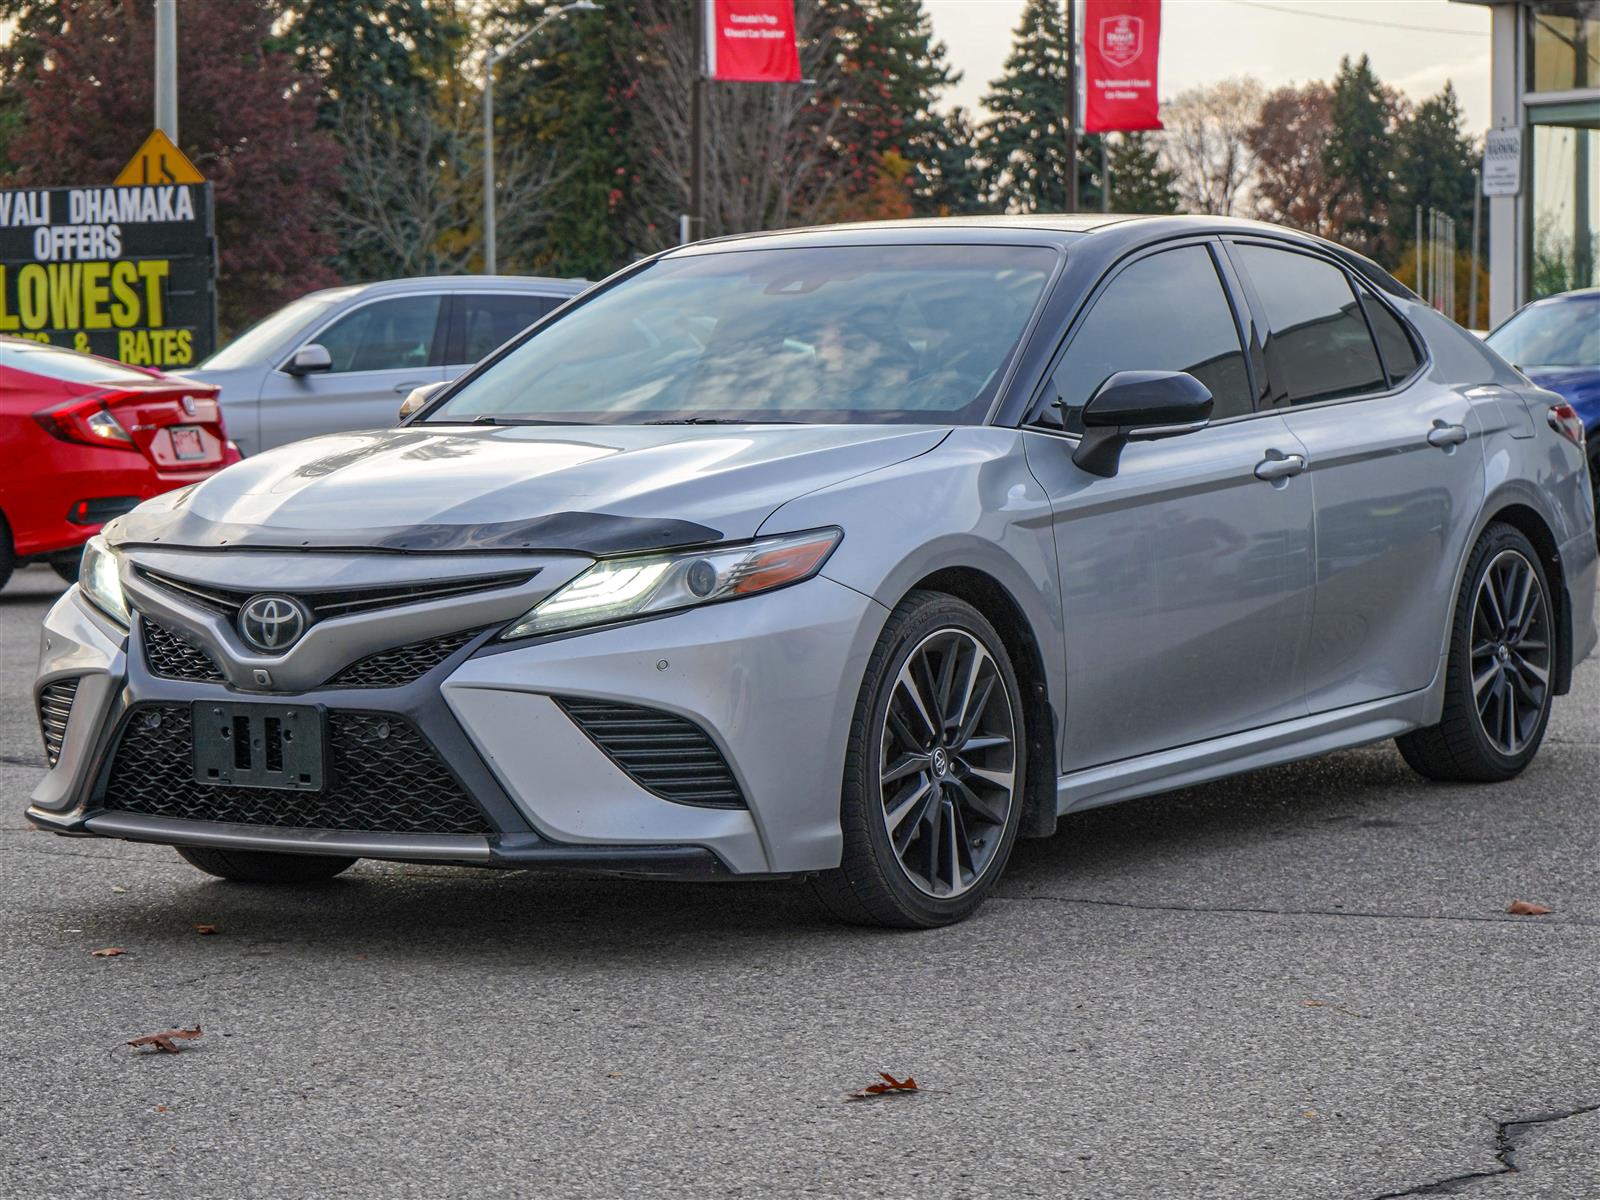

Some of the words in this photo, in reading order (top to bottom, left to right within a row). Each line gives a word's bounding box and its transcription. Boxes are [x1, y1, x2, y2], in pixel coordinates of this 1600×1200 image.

[69, 185, 195, 225] DHAMAKA
[34, 225, 122, 261] OFFERS
[0, 260, 169, 331] LOWEST
[118, 330, 193, 366] RATES
